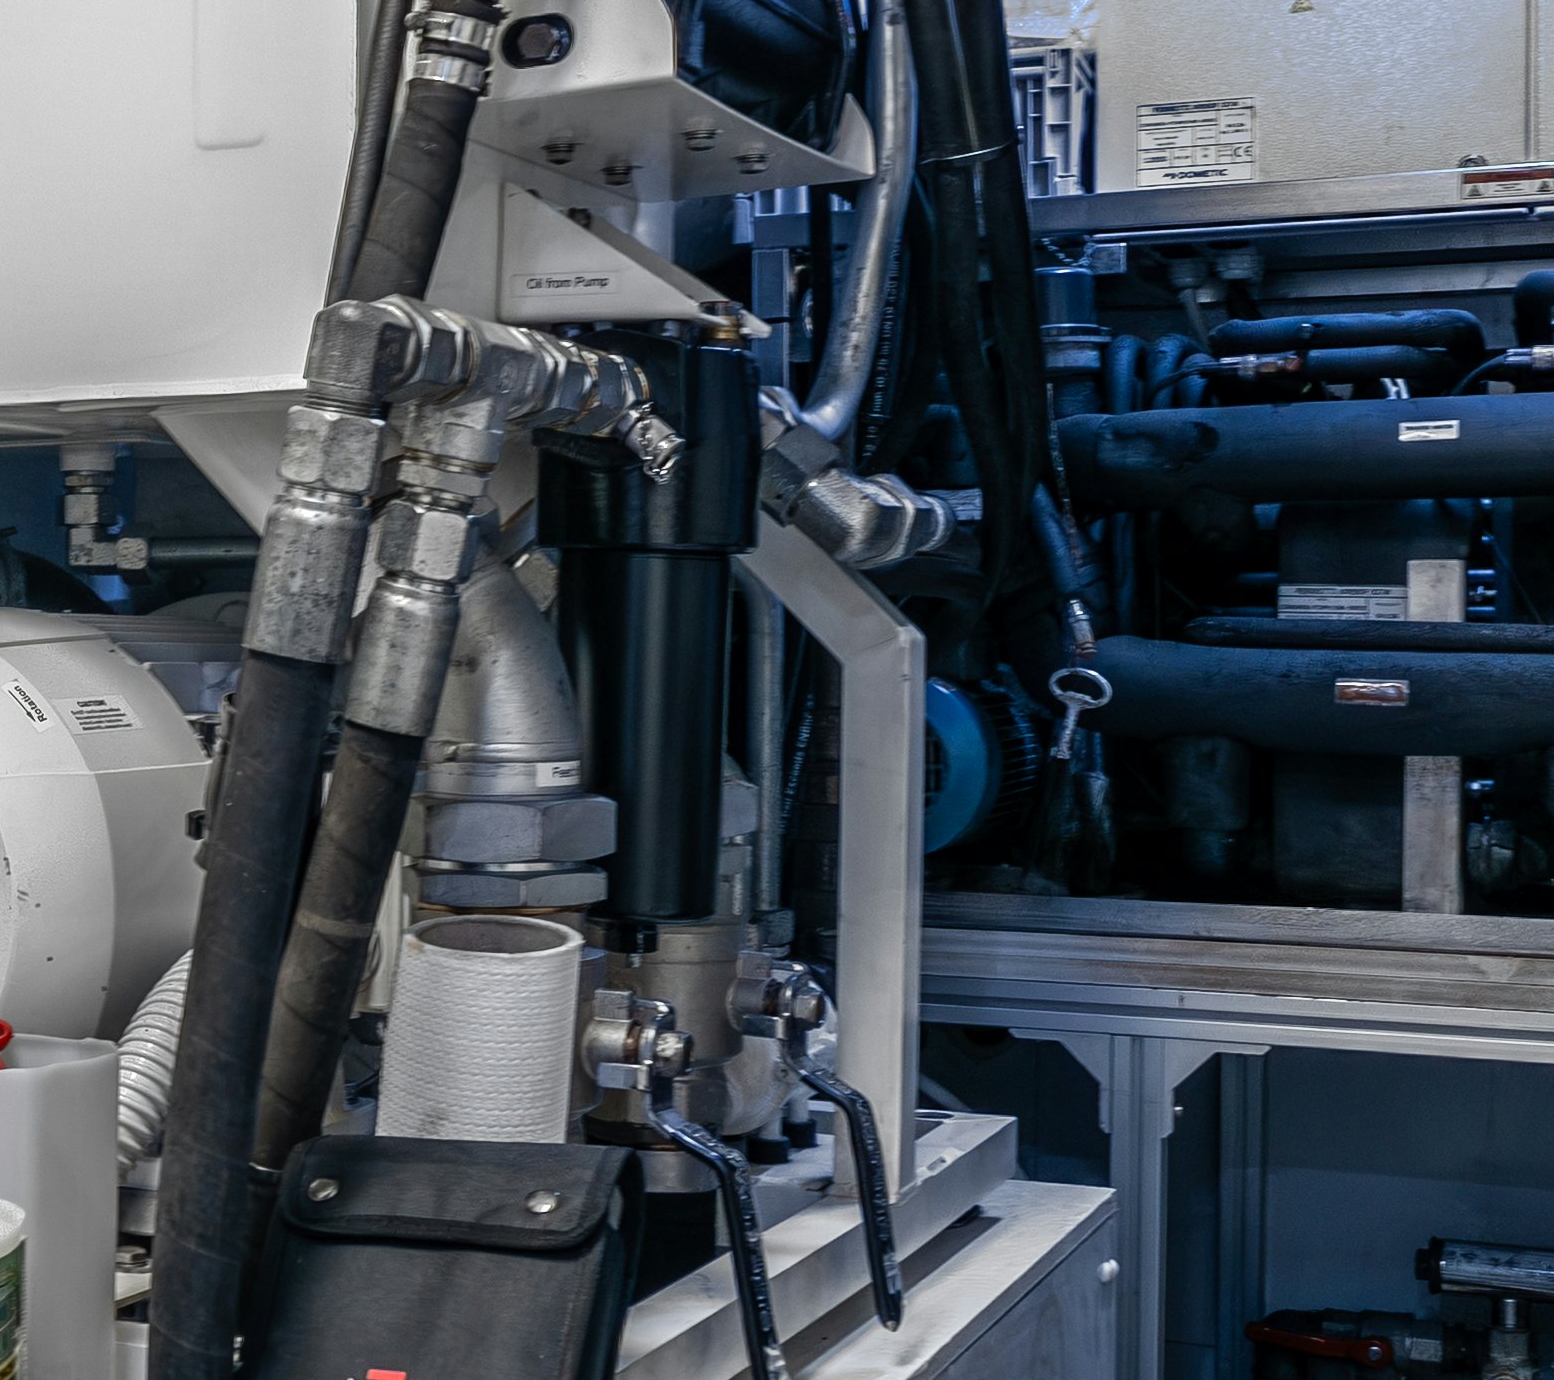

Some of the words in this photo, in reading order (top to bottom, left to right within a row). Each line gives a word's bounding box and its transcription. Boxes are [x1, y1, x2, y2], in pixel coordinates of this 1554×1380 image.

[526, 278, 543, 290] Oil
[545, 278, 572, 289] from
[574, 276, 611, 290] Pump
[14, 684, 48, 723] Rotation
